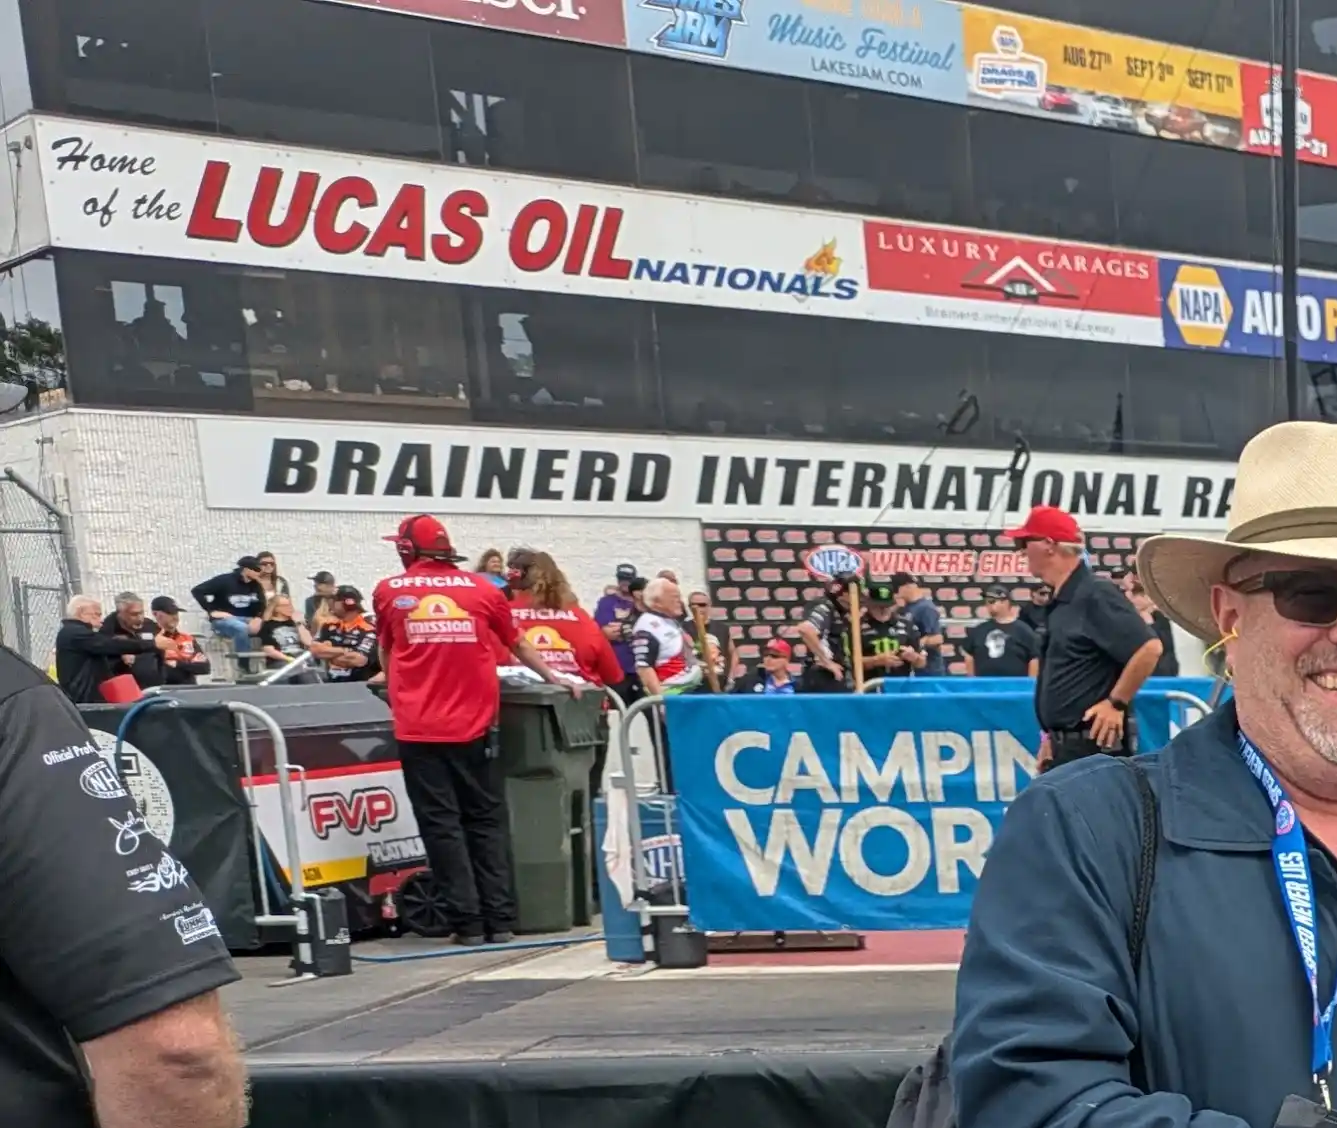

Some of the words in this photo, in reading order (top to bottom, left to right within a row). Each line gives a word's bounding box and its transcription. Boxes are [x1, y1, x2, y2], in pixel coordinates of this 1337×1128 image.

[662, 8, 728, 54] JAM
[769, 14, 846, 50] Music
[856, 28, 955, 71] Festival
[811, 56, 922, 88] LAKESJAM.COM
[1063, 45, 1087, 68] AUG
[1126, 56, 1154, 80] SEPT
[1187, 68, 1213, 92] SEPT
[52, 137, 156, 176] Home
[82, 195, 117, 223] of
[131, 187, 182, 221] the
[186, 160, 489, 264] LUCAS
[508, 198, 633, 279] OIL
[877, 231, 1000, 262] LUXURY
[1037, 250, 1150, 280] GARAGES
[634, 257, 859, 302] NATIONALS
[1179, 288, 1224, 325] NAPA
[1242, 289, 1321, 341] AUO
[265, 438, 672, 502] BRAINERD
[699, 454, 1162, 517] INTERNATIONAL
[870, 550, 974, 575] WINNERS
[389, 576, 477, 588] OFFICIAL
[408, 620, 474, 633] mission
[43, 746, 73, 766] Official
[310, 791, 397, 837] FVP
[1278, 852, 1308, 881] LIES
[1286, 881, 1312, 924] NEVER
